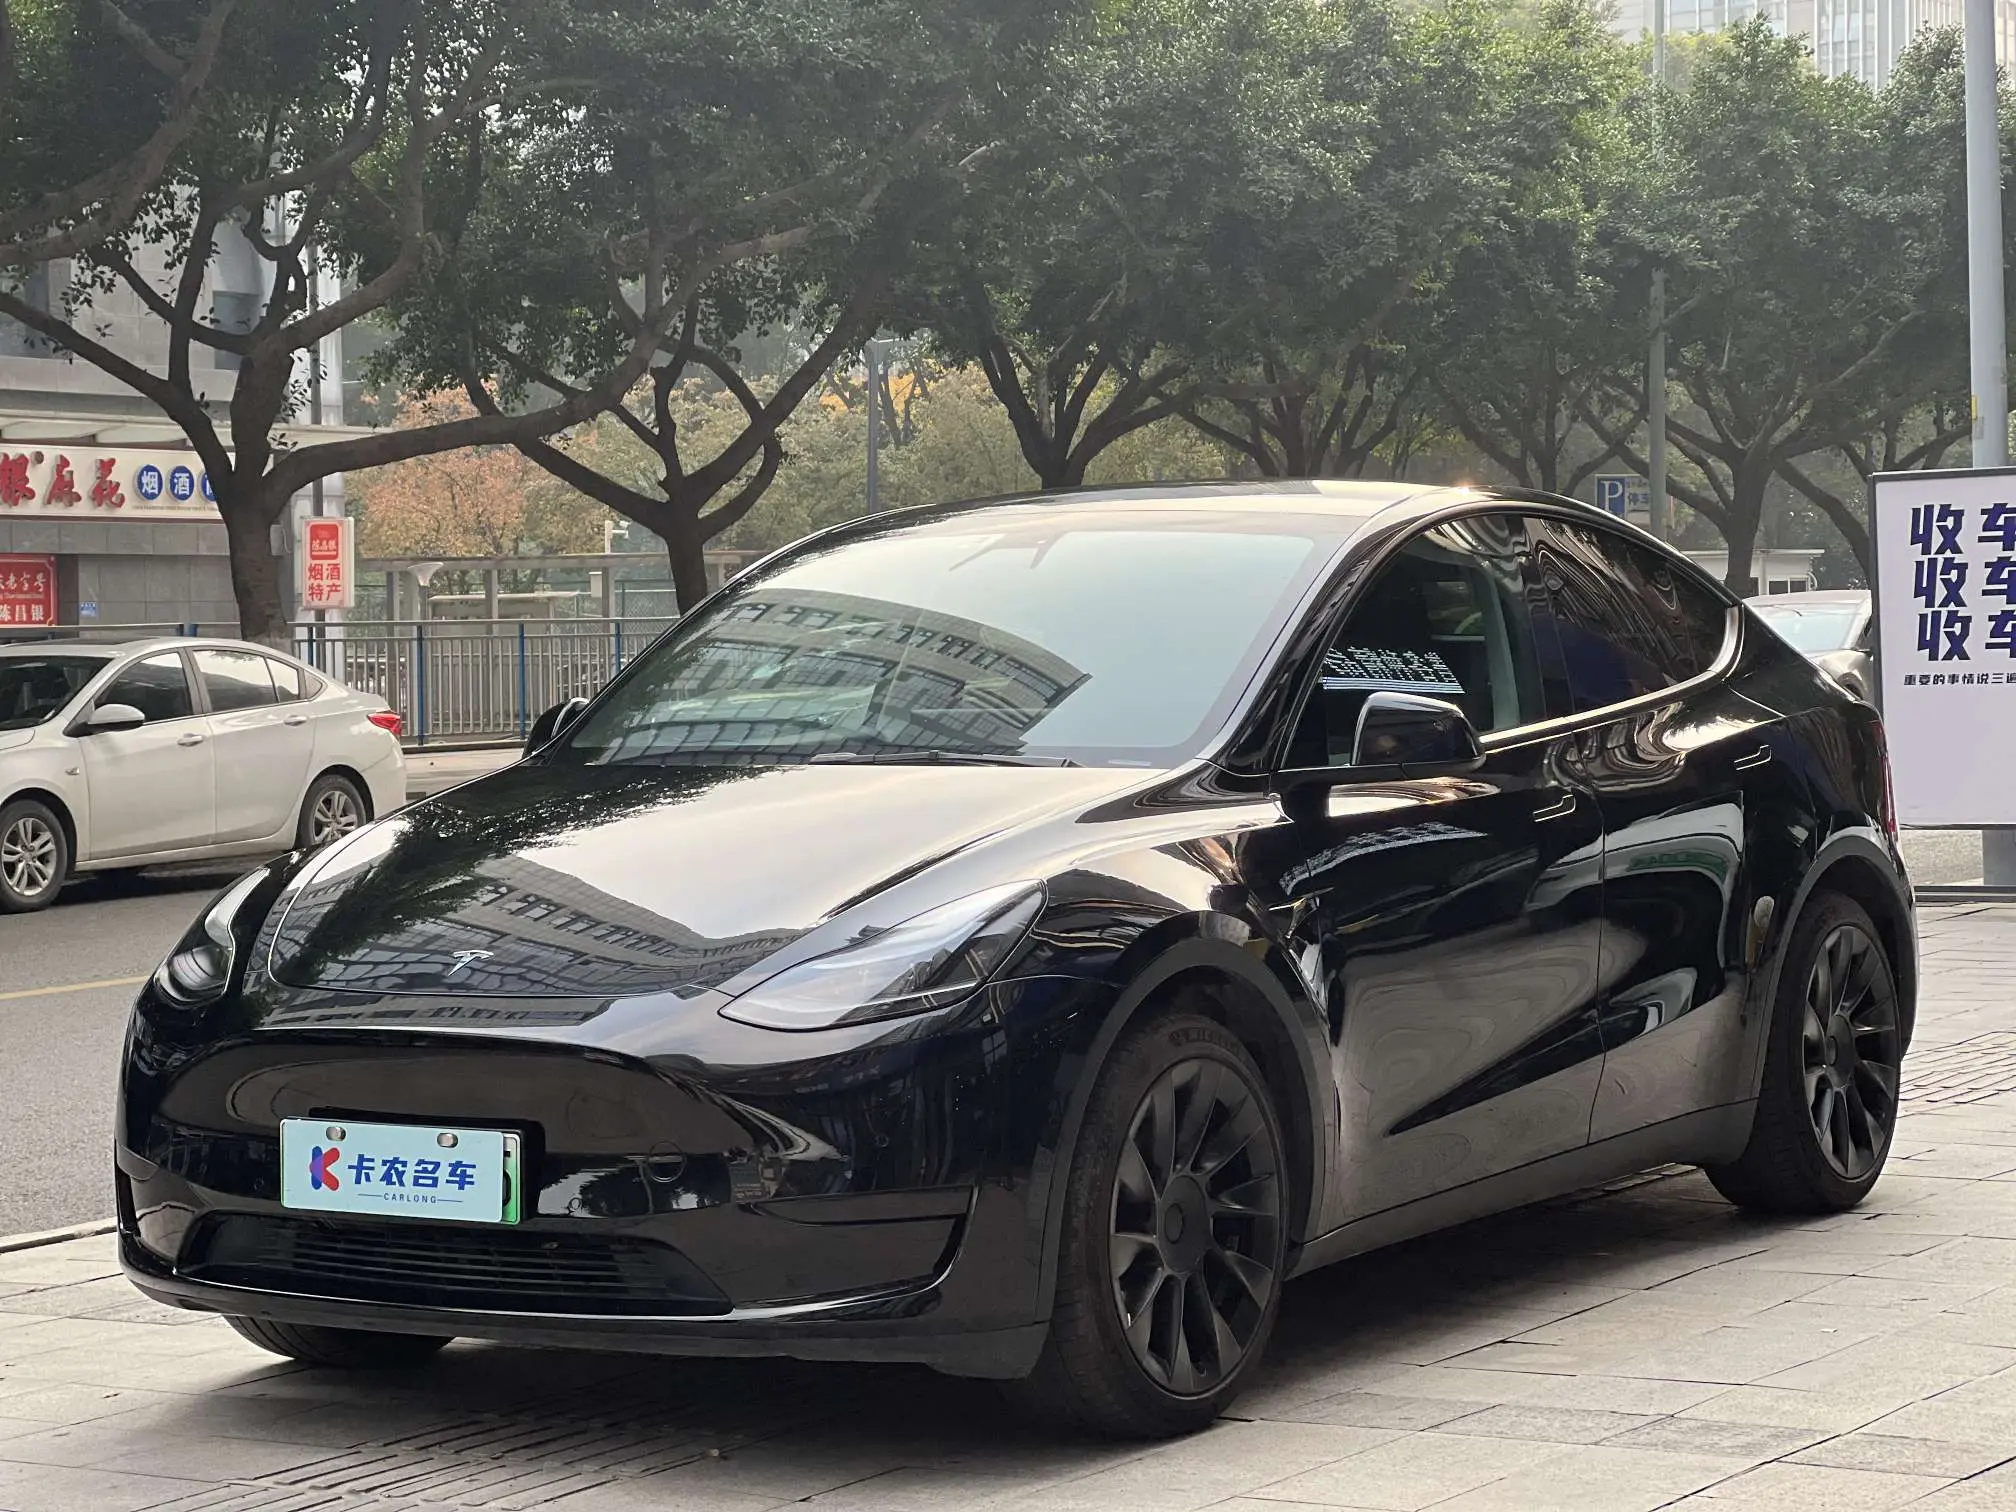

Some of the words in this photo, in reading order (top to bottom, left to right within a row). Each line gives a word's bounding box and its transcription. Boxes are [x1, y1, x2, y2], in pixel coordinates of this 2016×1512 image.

[1600, 481, 1624, 513] P
[308, 563, 341, 580] 烟酒
[308, 582, 342, 601] 特产
[347, 1153, 477, 1191] 卡农名车
[383, 1192, 438, 1205] CARLONG
